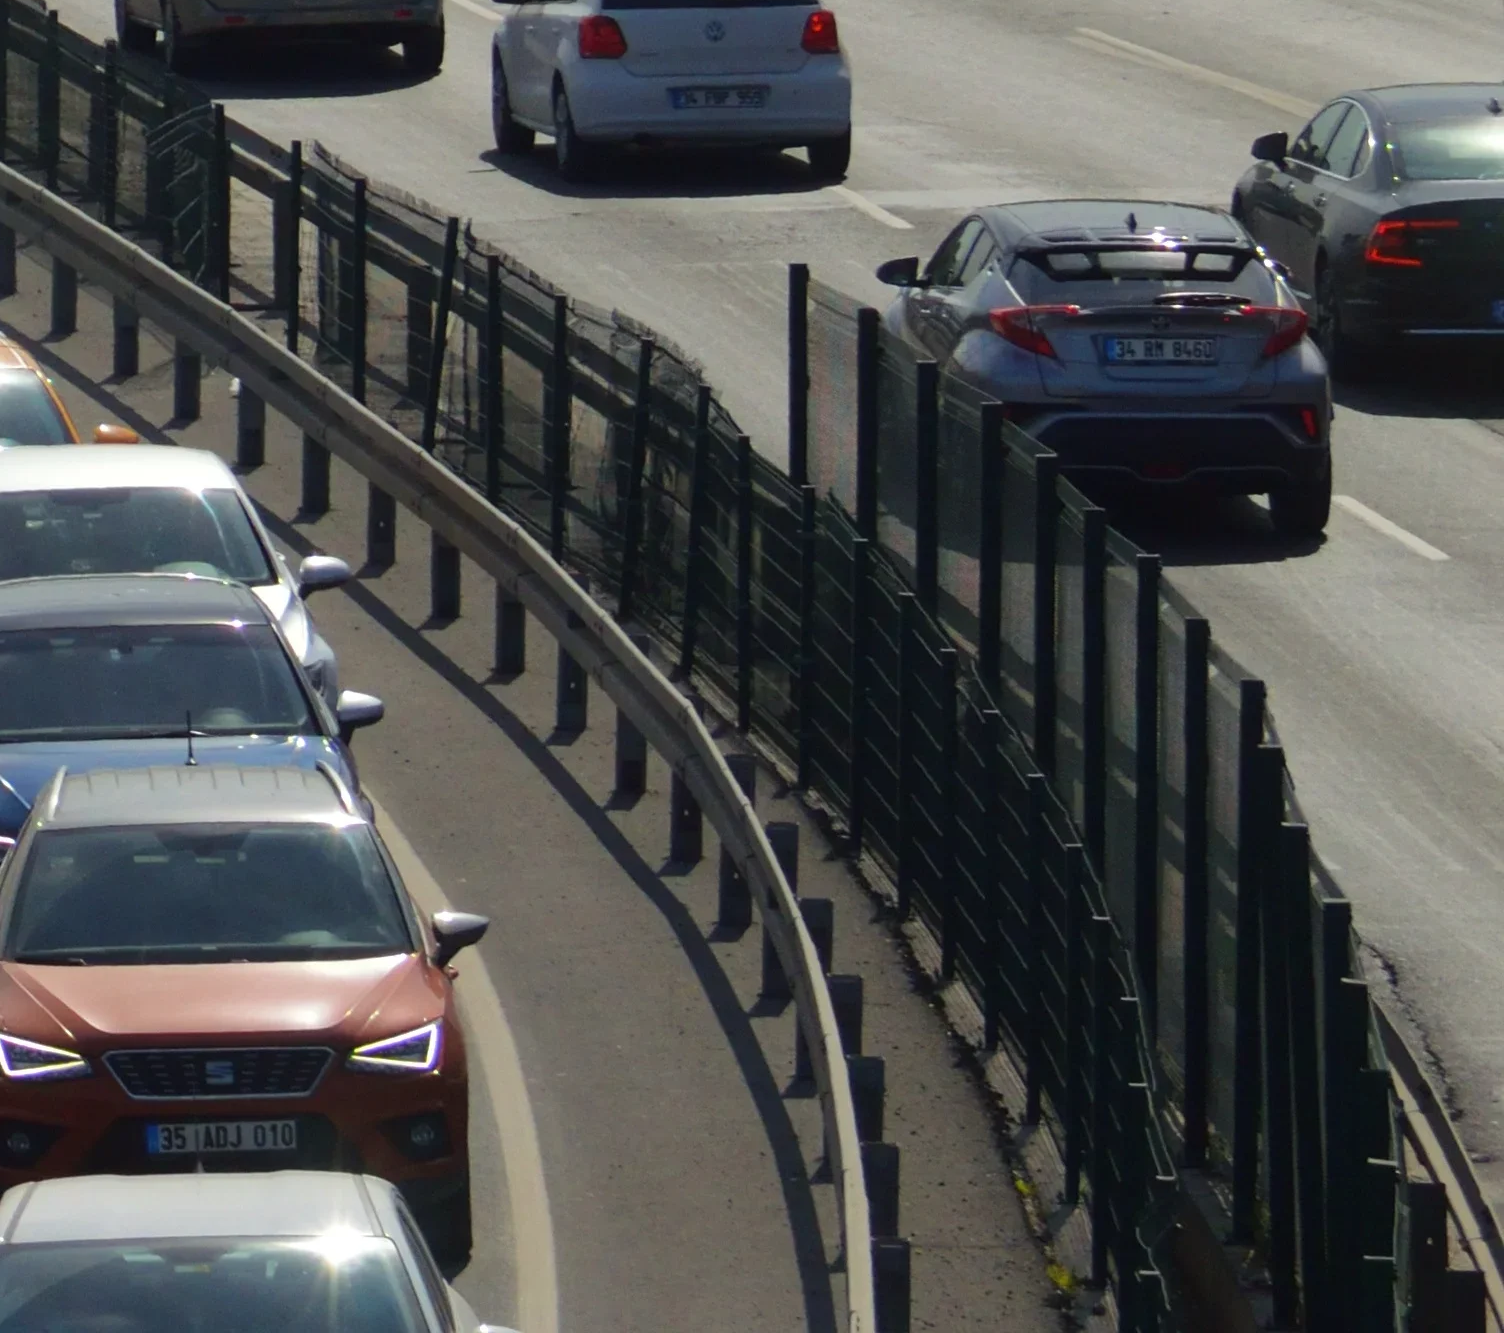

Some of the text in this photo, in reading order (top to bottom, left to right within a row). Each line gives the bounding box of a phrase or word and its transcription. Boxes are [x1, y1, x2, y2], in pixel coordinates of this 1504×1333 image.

[1116, 341, 1136, 358] 34
[160, 1123, 294, 1150] 35 ADJ 010
